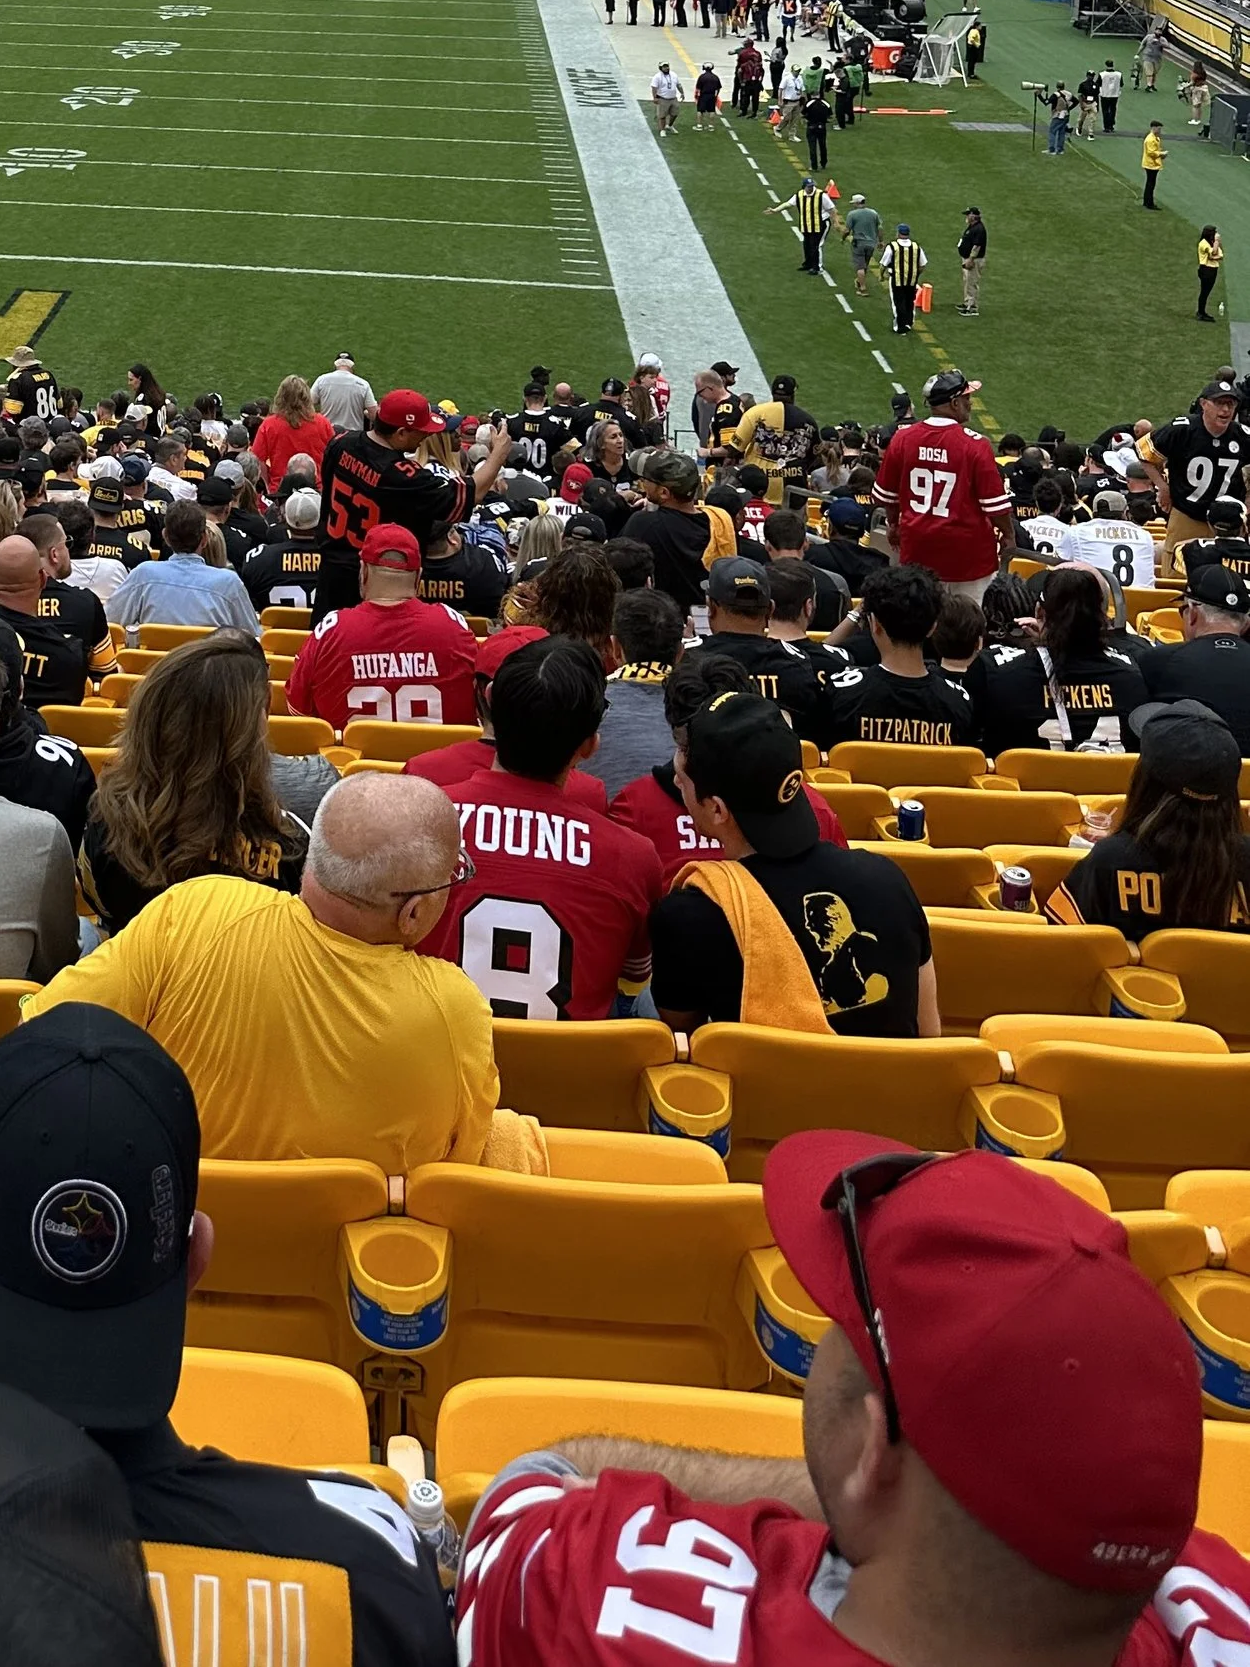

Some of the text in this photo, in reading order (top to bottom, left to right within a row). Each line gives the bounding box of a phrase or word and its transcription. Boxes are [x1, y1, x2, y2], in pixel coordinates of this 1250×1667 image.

[784, 0, 795, 12] K
[60, 86, 141, 107] 20
[36, 385, 58, 419] 86
[918, 446, 949, 464] BOSA
[337, 448, 382, 489] BOWMAN
[1186, 456, 1241, 503] 97
[908, 467, 958, 518] 97
[116, 508, 147, 529] RRIS
[326, 475, 382, 551] 53
[744, 506, 766, 519] ICE
[1016, 505, 1040, 517] HEYW
[1094, 526, 1140, 542] PICKETT
[88, 543, 123, 559] ARRIS
[281, 552, 322, 573] HARR
[1111, 543, 1135, 587] 8
[1221, 557, 1250, 576] WATT
[417, 580, 465, 600] ARRIS
[351, 652, 439, 680] HUFANGA
[1044, 684, 1113, 711] PCKENS
[860, 716, 952, 745] FITZPATRICK
[452, 799, 592, 868] YOUNG
[460, 895, 572, 1021] 8
[44, 1217, 79, 1237] Steelers
[596, 1504, 760, 1665] 97
